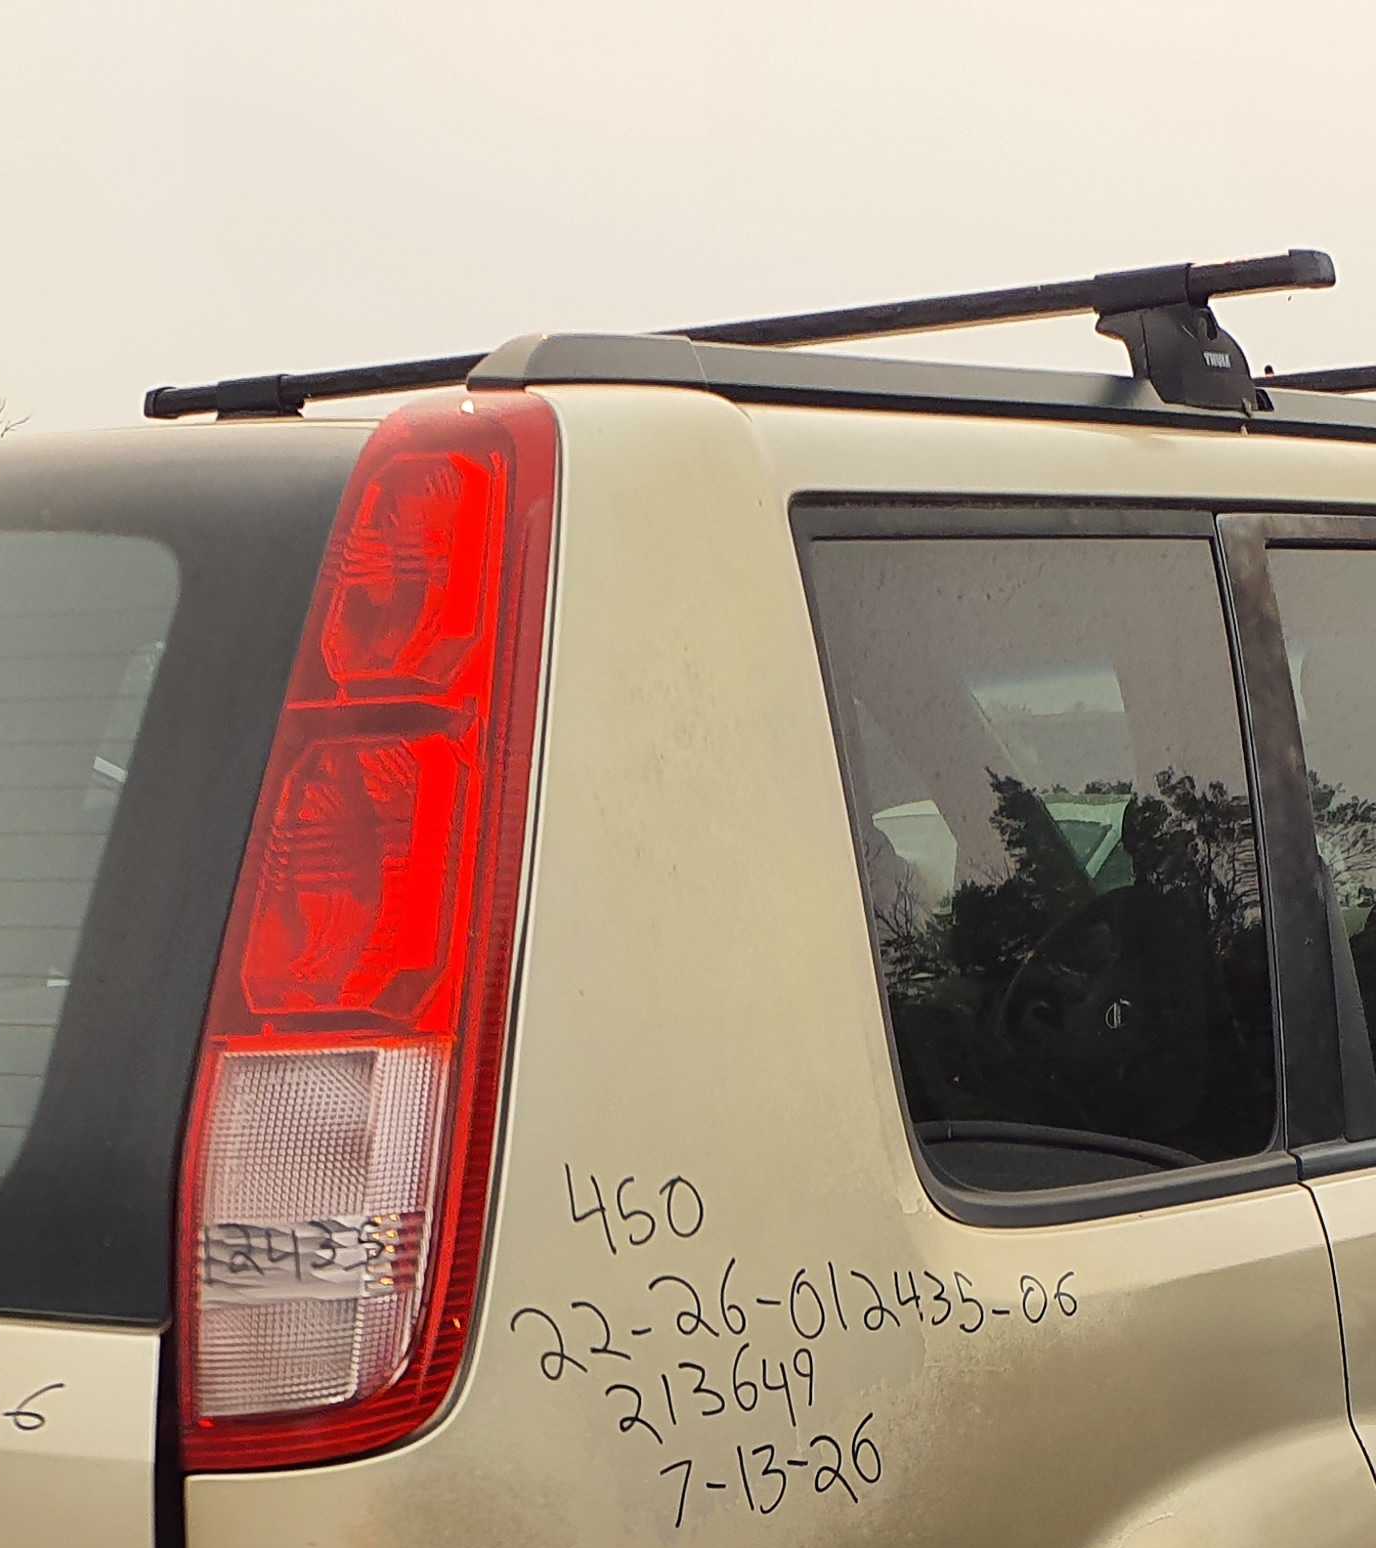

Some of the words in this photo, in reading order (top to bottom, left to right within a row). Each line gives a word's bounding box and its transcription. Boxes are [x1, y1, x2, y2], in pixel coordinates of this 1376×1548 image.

[565, 1163, 704, 1255] 450
[511, 1257, 1079, 1381] 22-26-012435-06
[605, 1342, 814, 1444] 213649
[660, 1412, 882, 1529] 7-13-26
